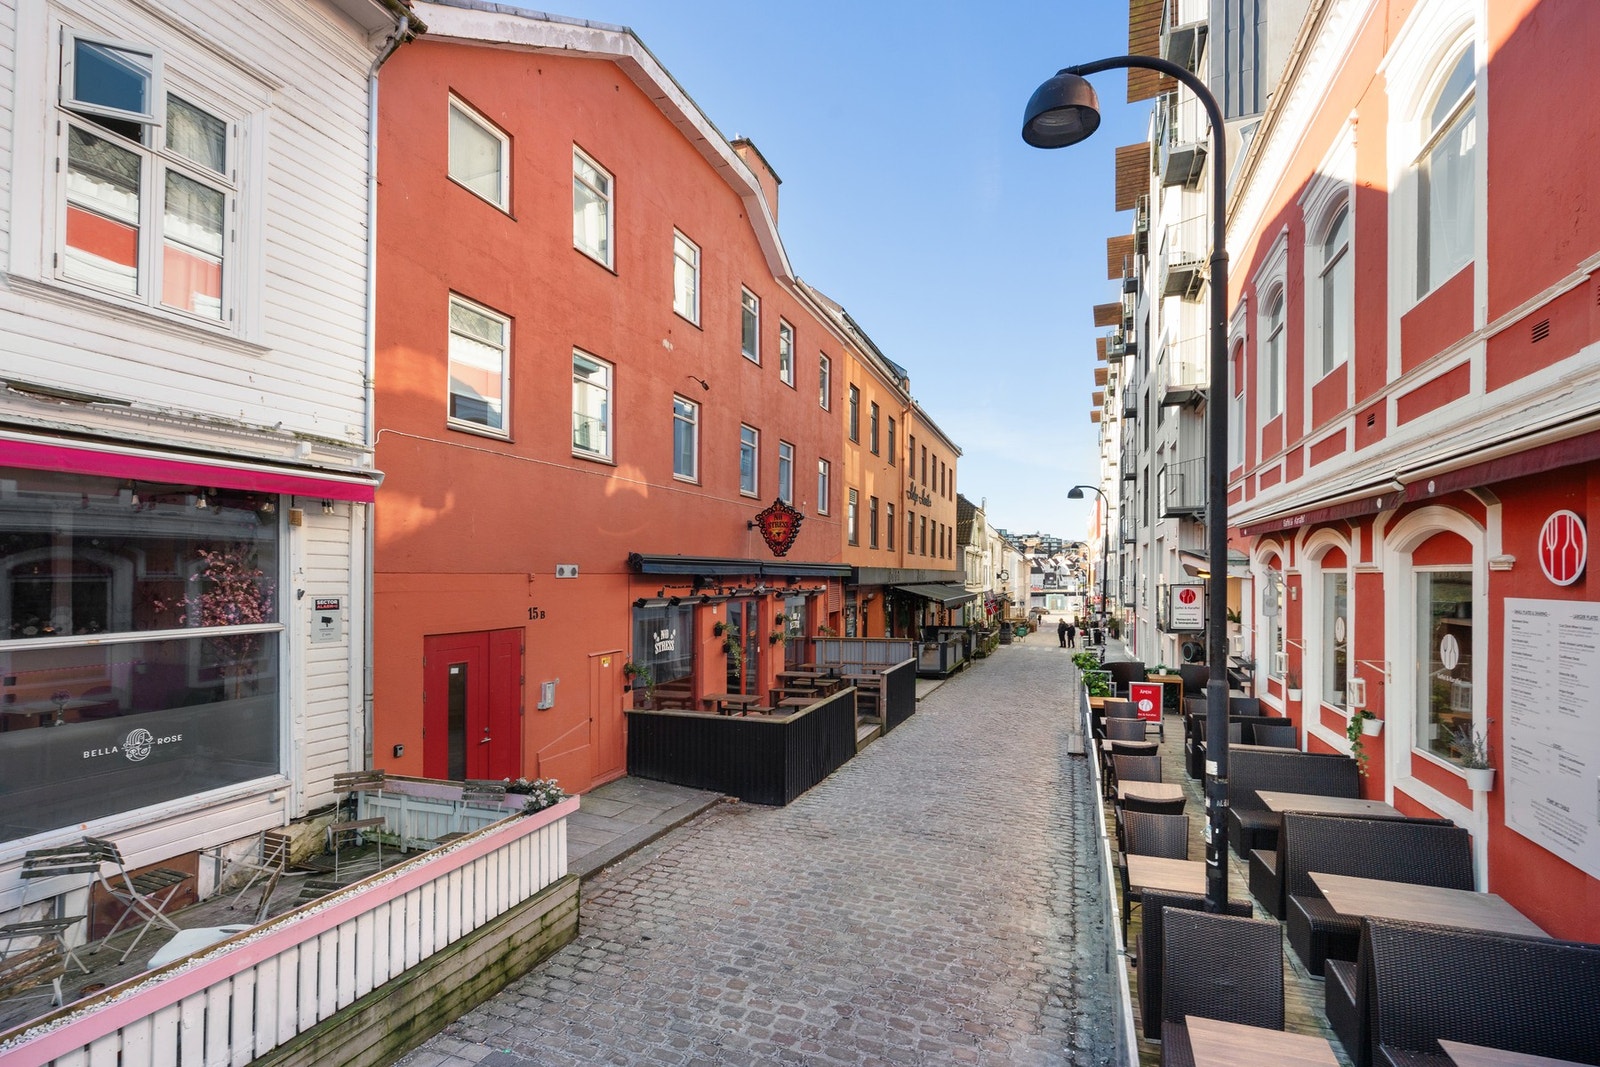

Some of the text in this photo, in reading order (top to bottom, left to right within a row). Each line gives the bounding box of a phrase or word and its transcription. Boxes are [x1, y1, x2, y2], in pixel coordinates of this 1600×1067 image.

[528, 607, 546, 620] 15 B
[660, 629, 669, 640] NO
[655, 640, 675, 655] STRESS
[83, 734, 183, 759] BELLA ROSE
